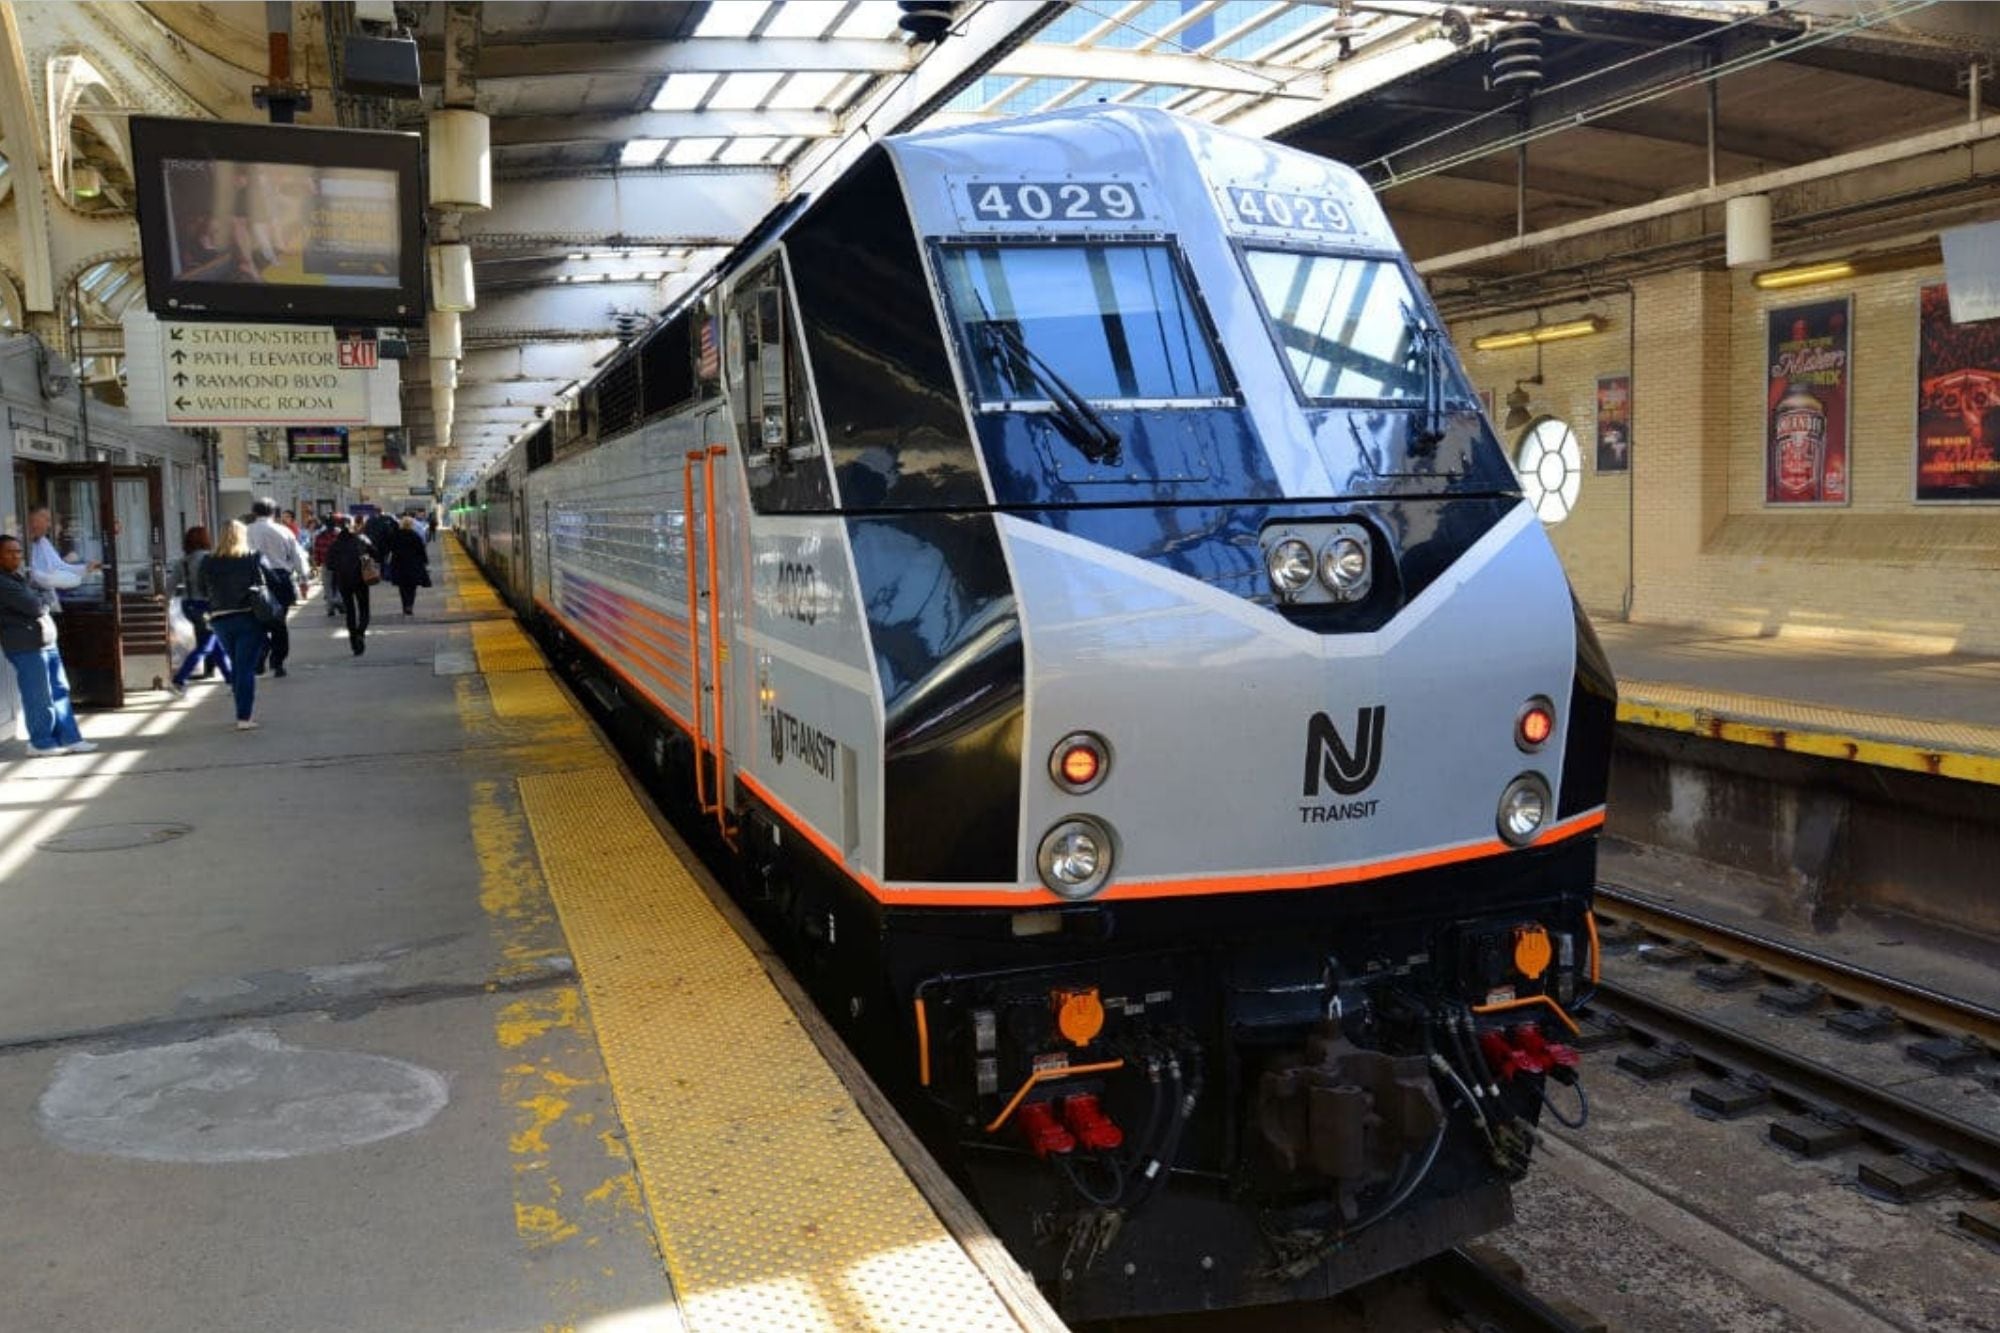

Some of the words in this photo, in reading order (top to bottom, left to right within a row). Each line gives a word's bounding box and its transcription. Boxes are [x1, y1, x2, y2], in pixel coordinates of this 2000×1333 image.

[977, 184, 1137, 219] 4029
[1237, 191, 1349, 230] 4029
[191, 328, 331, 345] STATION/STREET
[250, 351, 335, 367] ELEVATOR
[339, 342, 376, 367] EXIT
[195, 374, 288, 389] RAYMOND
[197, 396, 270, 411] WAITING
[278, 396, 335, 410] ROOM
[784, 713, 836, 782] TRANSIT
[1303, 704, 1385, 796] NJ
[1299, 800, 1380, 823] TRANSIT
